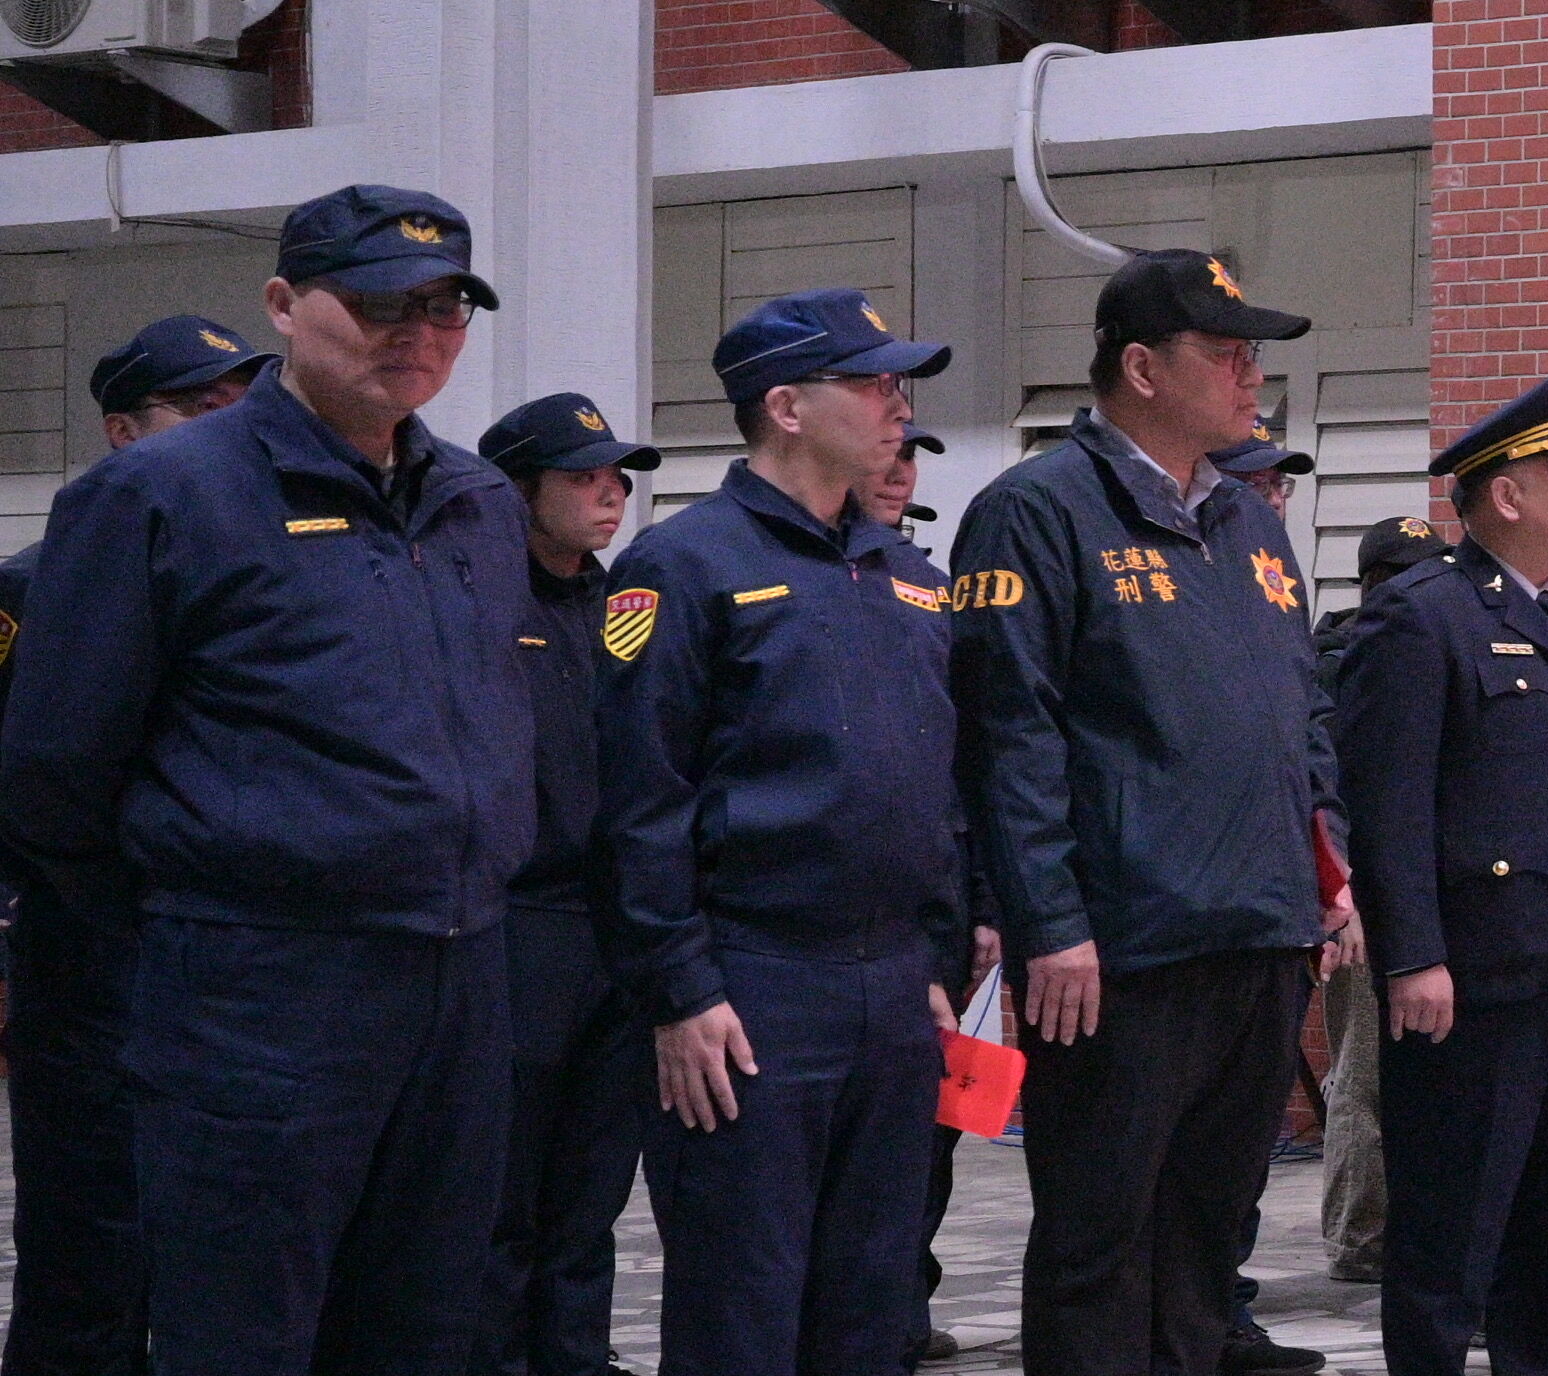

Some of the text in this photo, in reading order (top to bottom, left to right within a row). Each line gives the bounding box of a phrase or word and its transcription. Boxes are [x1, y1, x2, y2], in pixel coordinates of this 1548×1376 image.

[1101, 546, 1169, 572] 花蓮縣
[952, 569, 1025, 612] CID
[1114, 572, 1179, 604] 刑警
